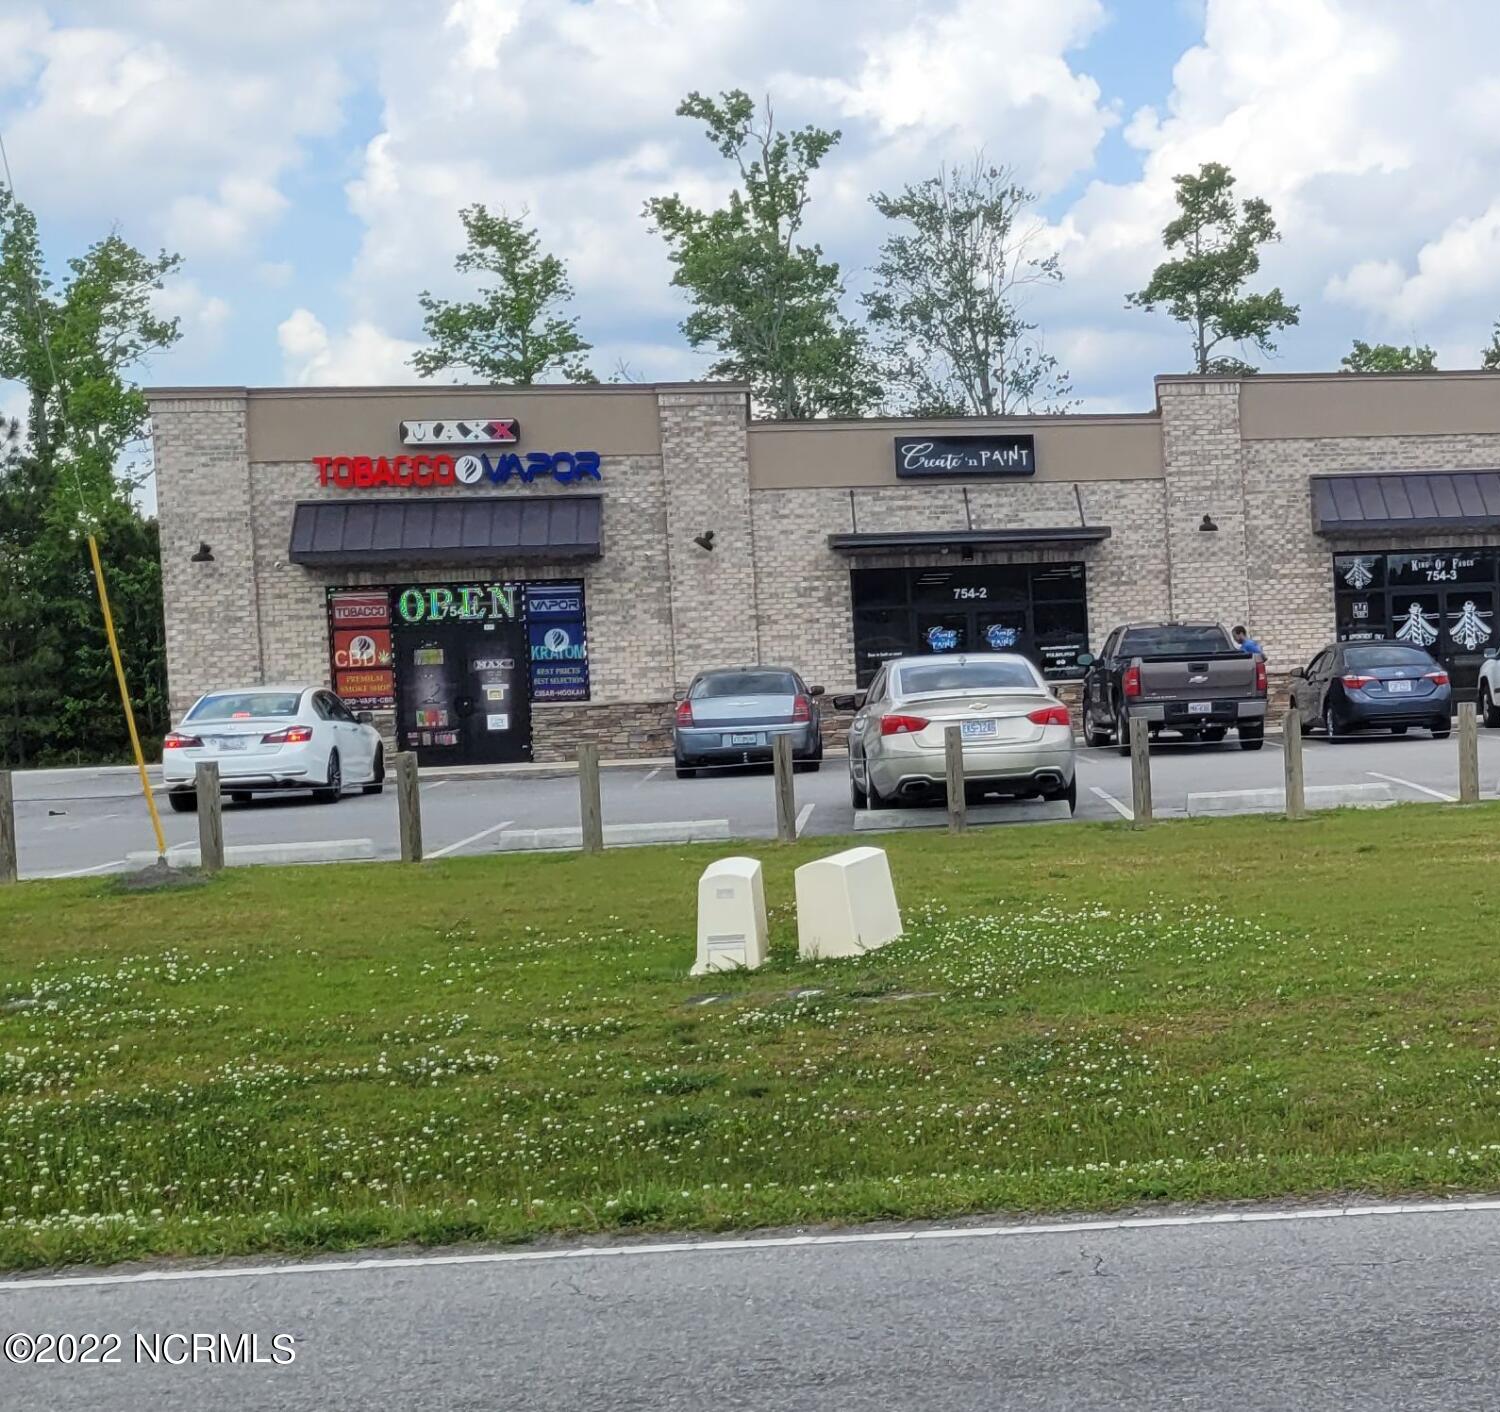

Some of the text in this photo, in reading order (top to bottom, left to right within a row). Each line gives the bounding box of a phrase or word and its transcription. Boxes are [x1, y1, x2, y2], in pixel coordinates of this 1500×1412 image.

[403, 420, 515, 444] MAXX
[901, 442, 964, 469] Create
[979, 445, 1029, 467] PAINT
[312, 451, 602, 488] TOBACCO VAPOR
[1426, 570, 1457, 581] 754-3
[953, 588, 987, 599] 754-2
[335, 607, 385, 617] TOBACCO
[400, 586, 518, 622] OPEN
[530, 600, 579, 611] VAPOR
[335, 650, 376, 667] CBD
